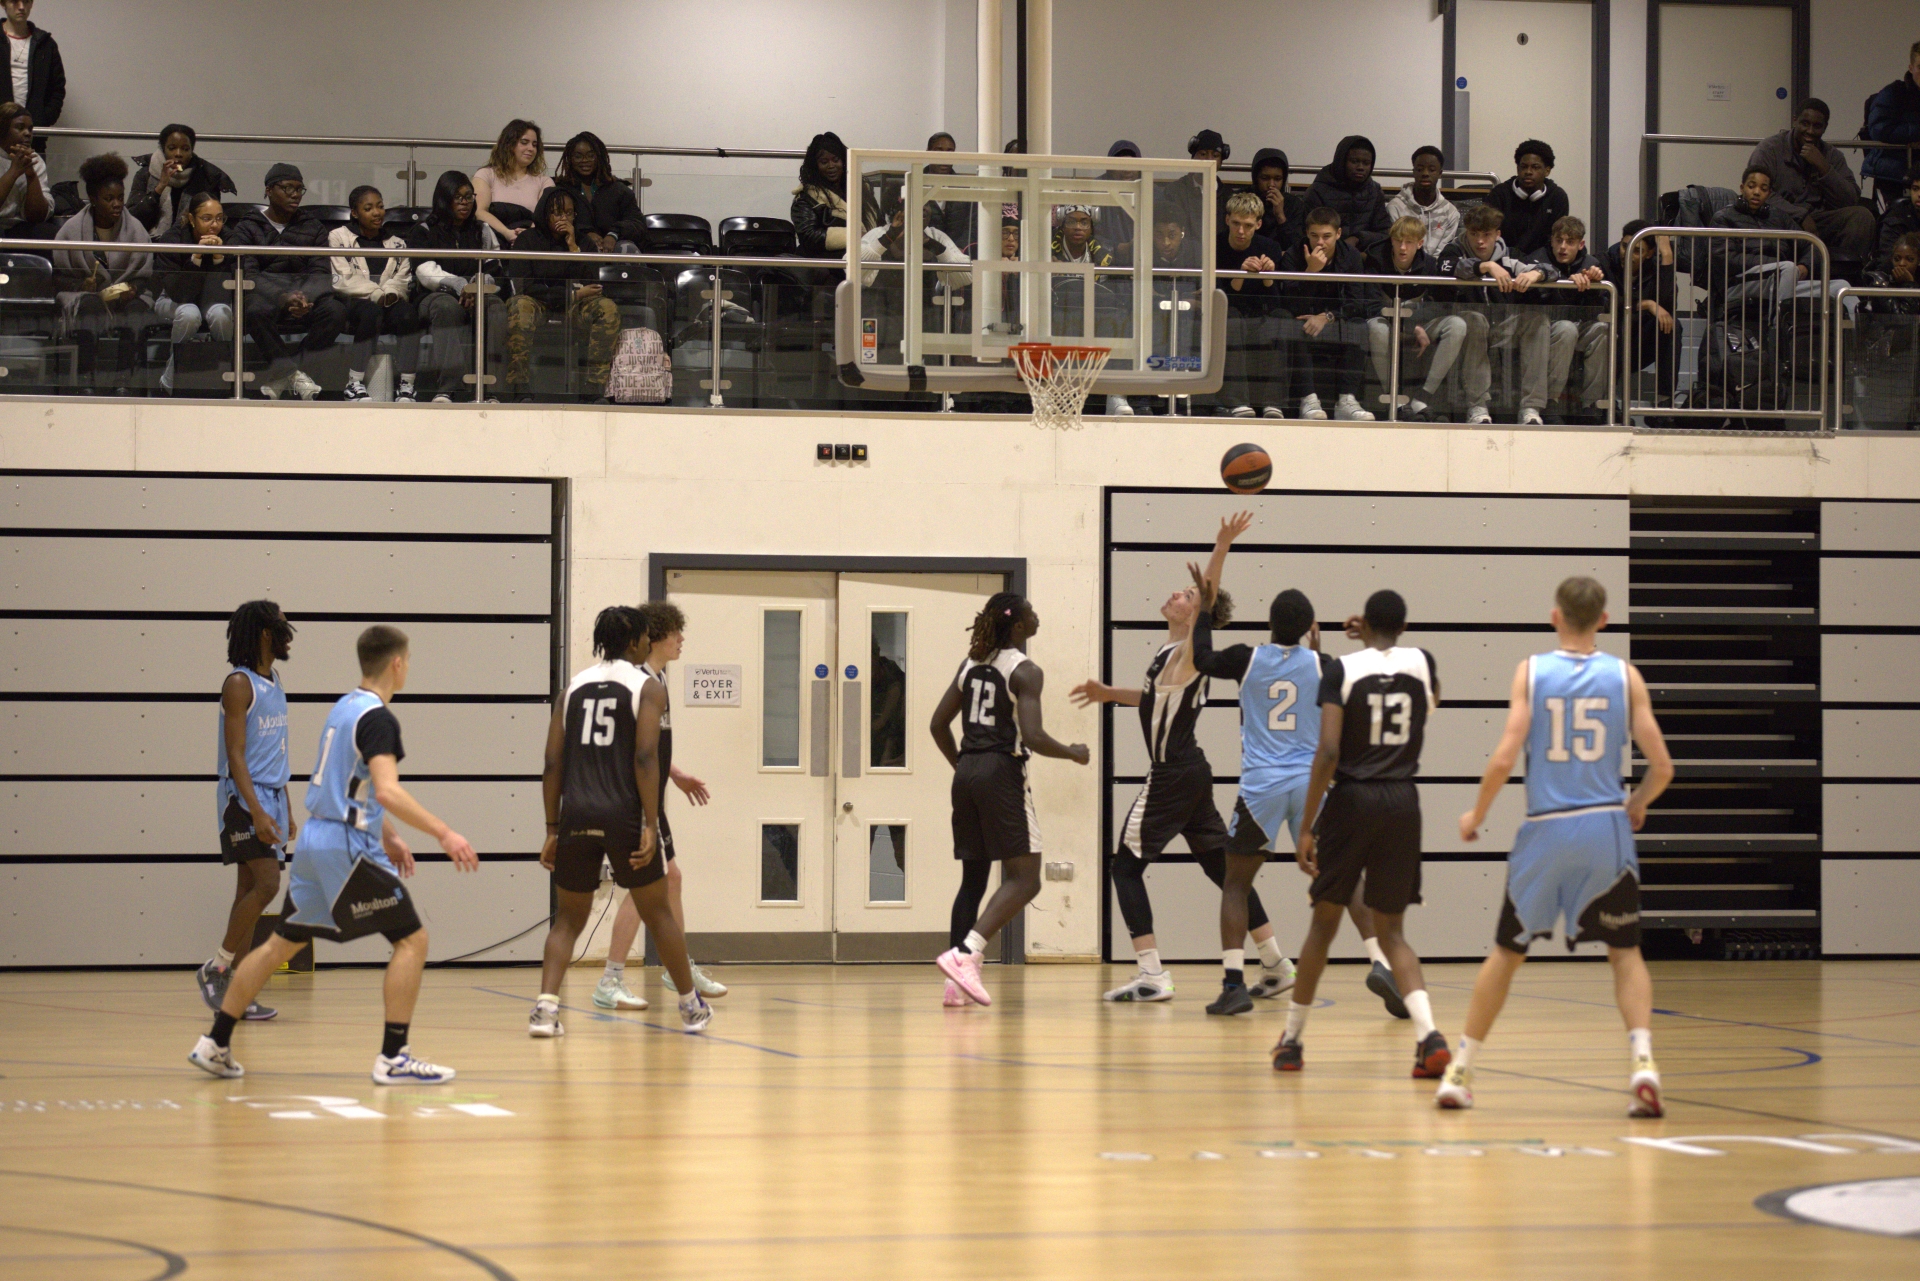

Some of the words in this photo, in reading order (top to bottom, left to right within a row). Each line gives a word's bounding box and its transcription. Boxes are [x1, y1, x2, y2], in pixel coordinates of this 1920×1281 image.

[693, 680, 733, 688] FOYER
[693, 690, 700, 699] &
[706, 690, 733, 699] EXIT
[968, 678, 997, 727] 12
[1267, 680, 1298, 731] 2
[581, 698, 617, 746] 15
[1366, 693, 1412, 746] 13
[1545, 698, 1608, 763] 15
[313, 727, 336, 787] 1
[350, 896, 399, 915] Moulton
